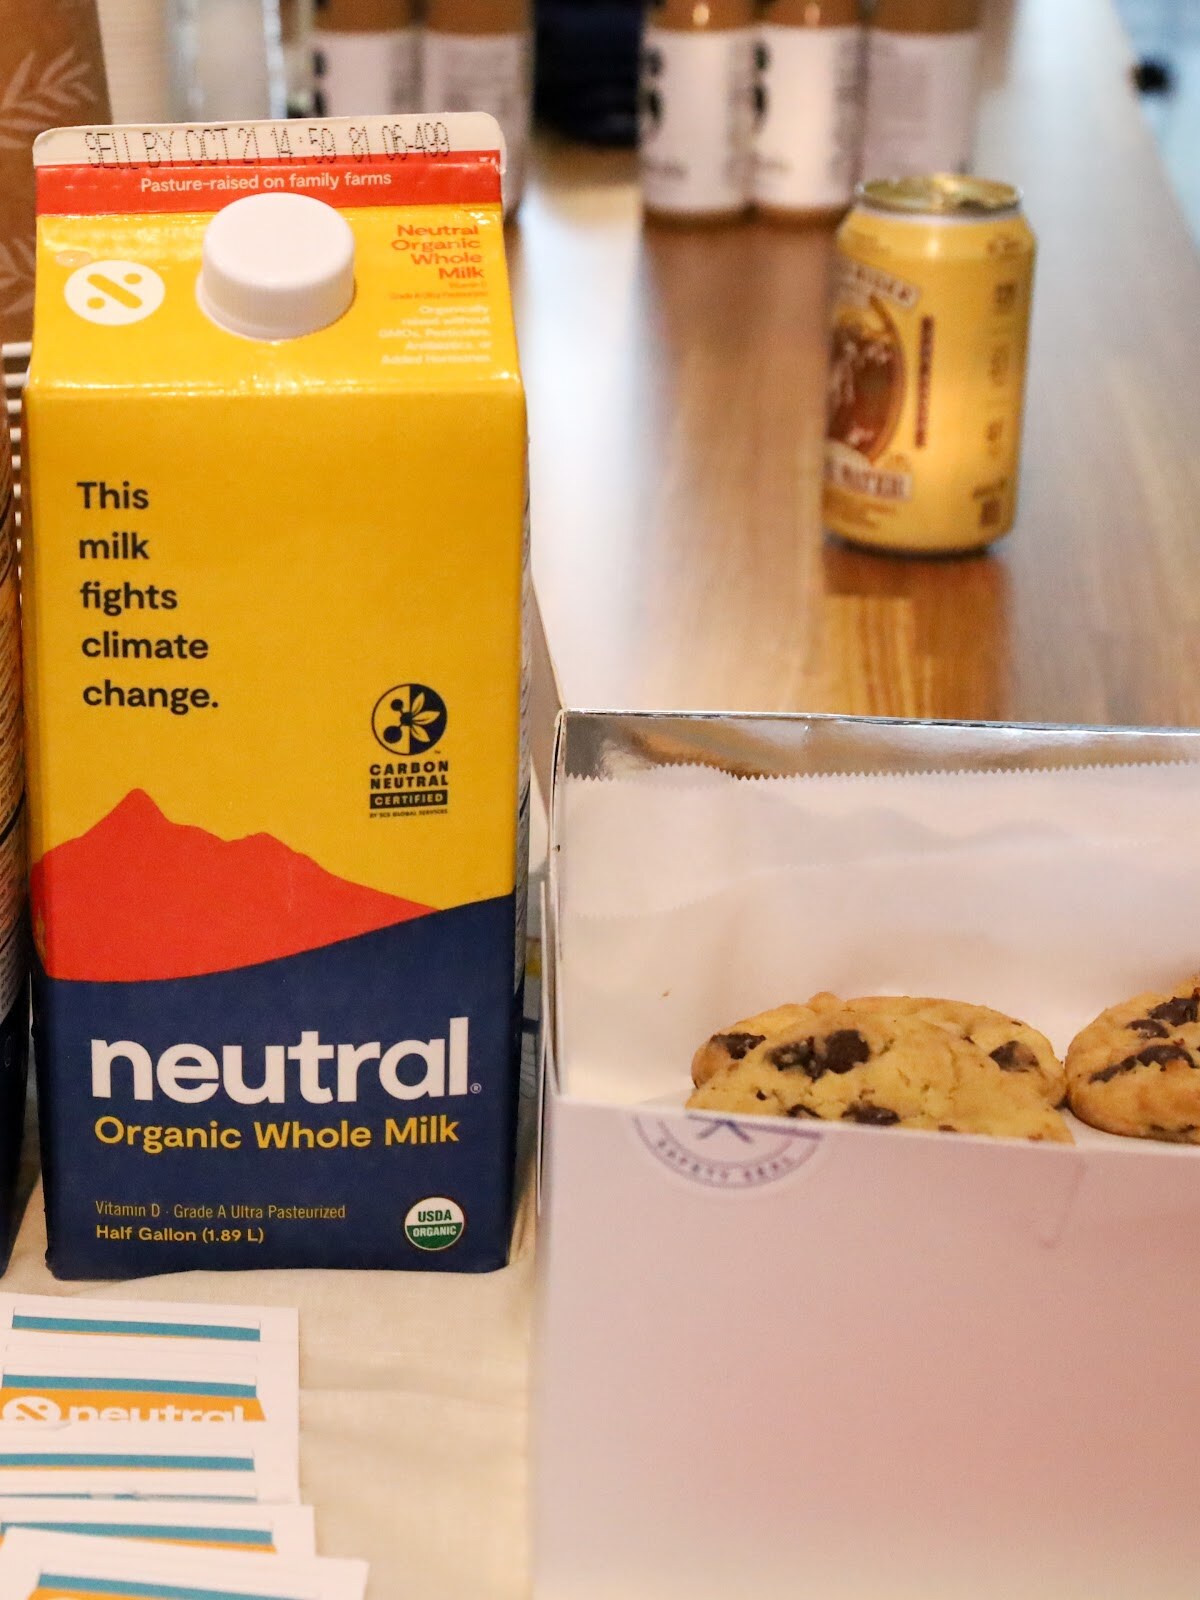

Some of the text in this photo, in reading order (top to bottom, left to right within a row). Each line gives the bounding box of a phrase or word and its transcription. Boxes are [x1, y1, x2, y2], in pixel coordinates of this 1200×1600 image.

[85, 132, 138, 170] SELL
[142, 130, 174, 168] BY
[185, 128, 230, 166] OCT
[237, 127, 261, 164] 21
[140, 172, 393, 193] Pasture-raised on family farms
[396, 224, 479, 237] Neutral
[390, 238, 481, 252] Organic
[410, 252, 483, 265] Whole
[438, 266, 486, 280] Milk
[76, 480, 149, 509] This
[79, 531, 150, 560] milk
[80, 581, 178, 616] fights
[81, 631, 209, 659] climate
[83, 679, 219, 716] change.
[370, 761, 449, 776] CARBON
[370, 774, 449, 790] NEUTRAL
[374, 793, 444, 807] CERTIFIED
[90, 1016, 469, 1104] neutral
[94, 1114, 460, 1154] Organic Whole Milk
[95, 1200, 346, 1219] Vitamin D Grade A Ultra Pasteurized
[417, 1209, 452, 1222] USDA
[96, 1225, 265, 1243] Half Gallon (1.89 L)
[412, 1225, 457, 1237] ORGANIC
